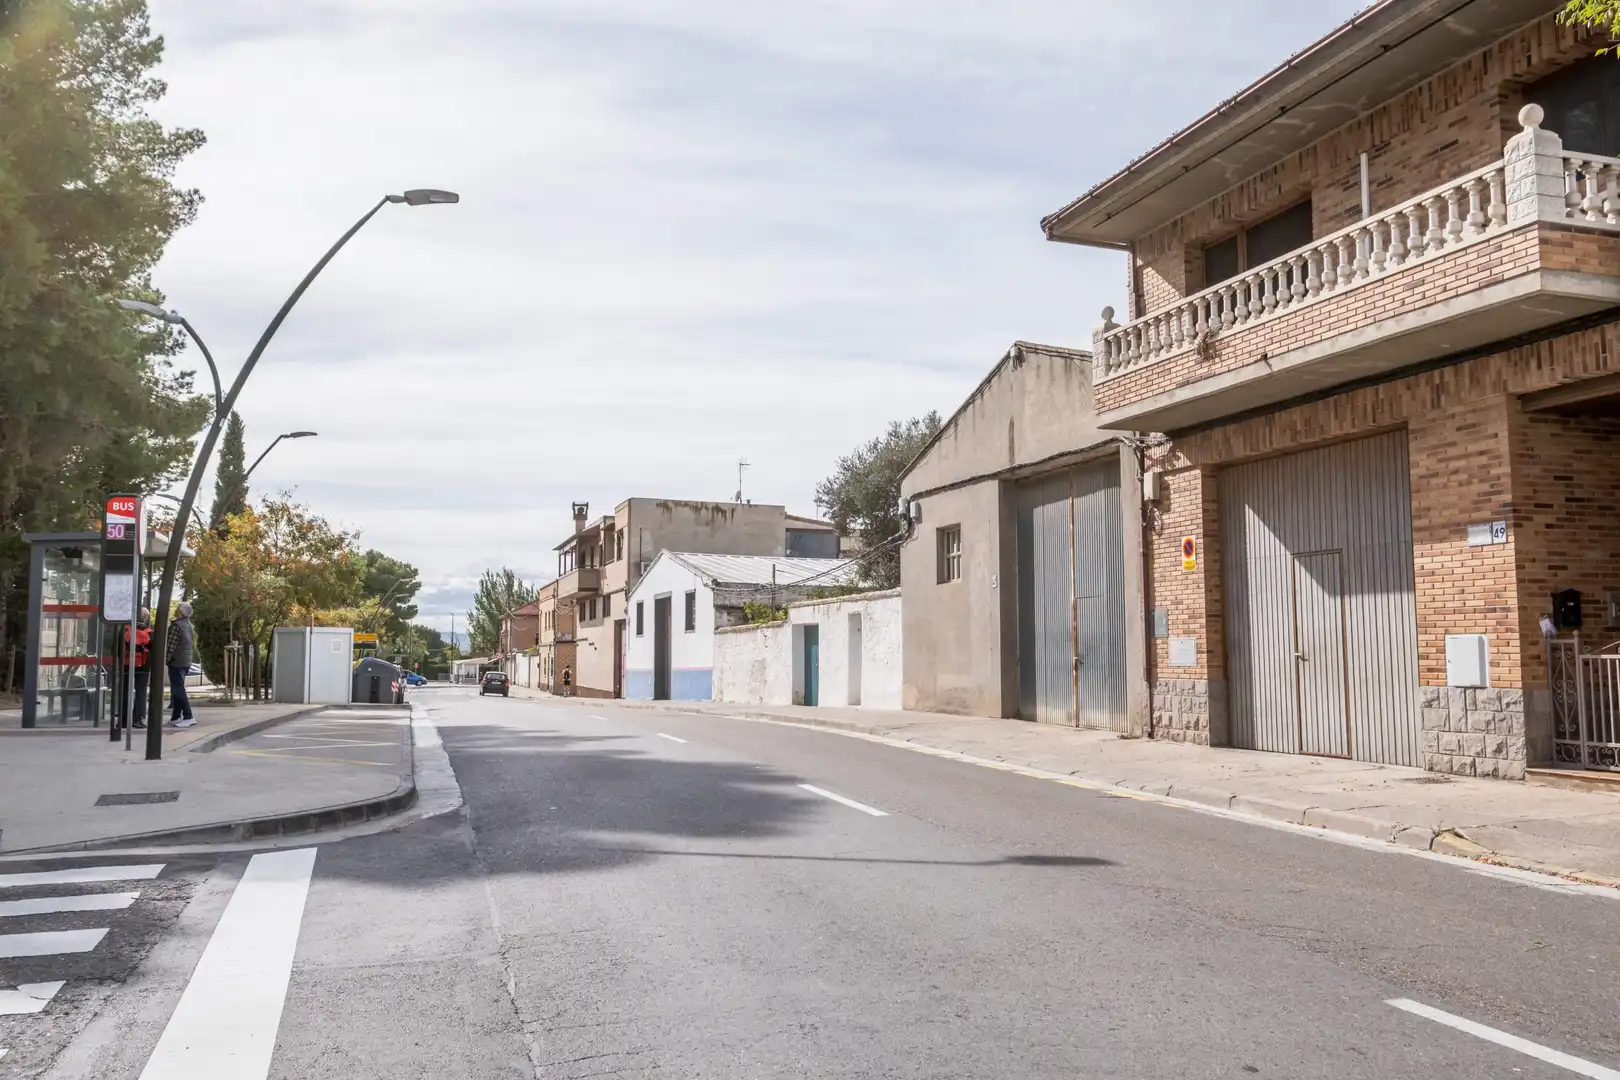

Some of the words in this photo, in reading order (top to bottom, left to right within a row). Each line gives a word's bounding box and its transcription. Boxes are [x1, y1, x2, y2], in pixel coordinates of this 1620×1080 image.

[112, 502, 134, 511] BUS
[108, 524, 124, 538] 50
[1494, 527, 1505, 539] 49
